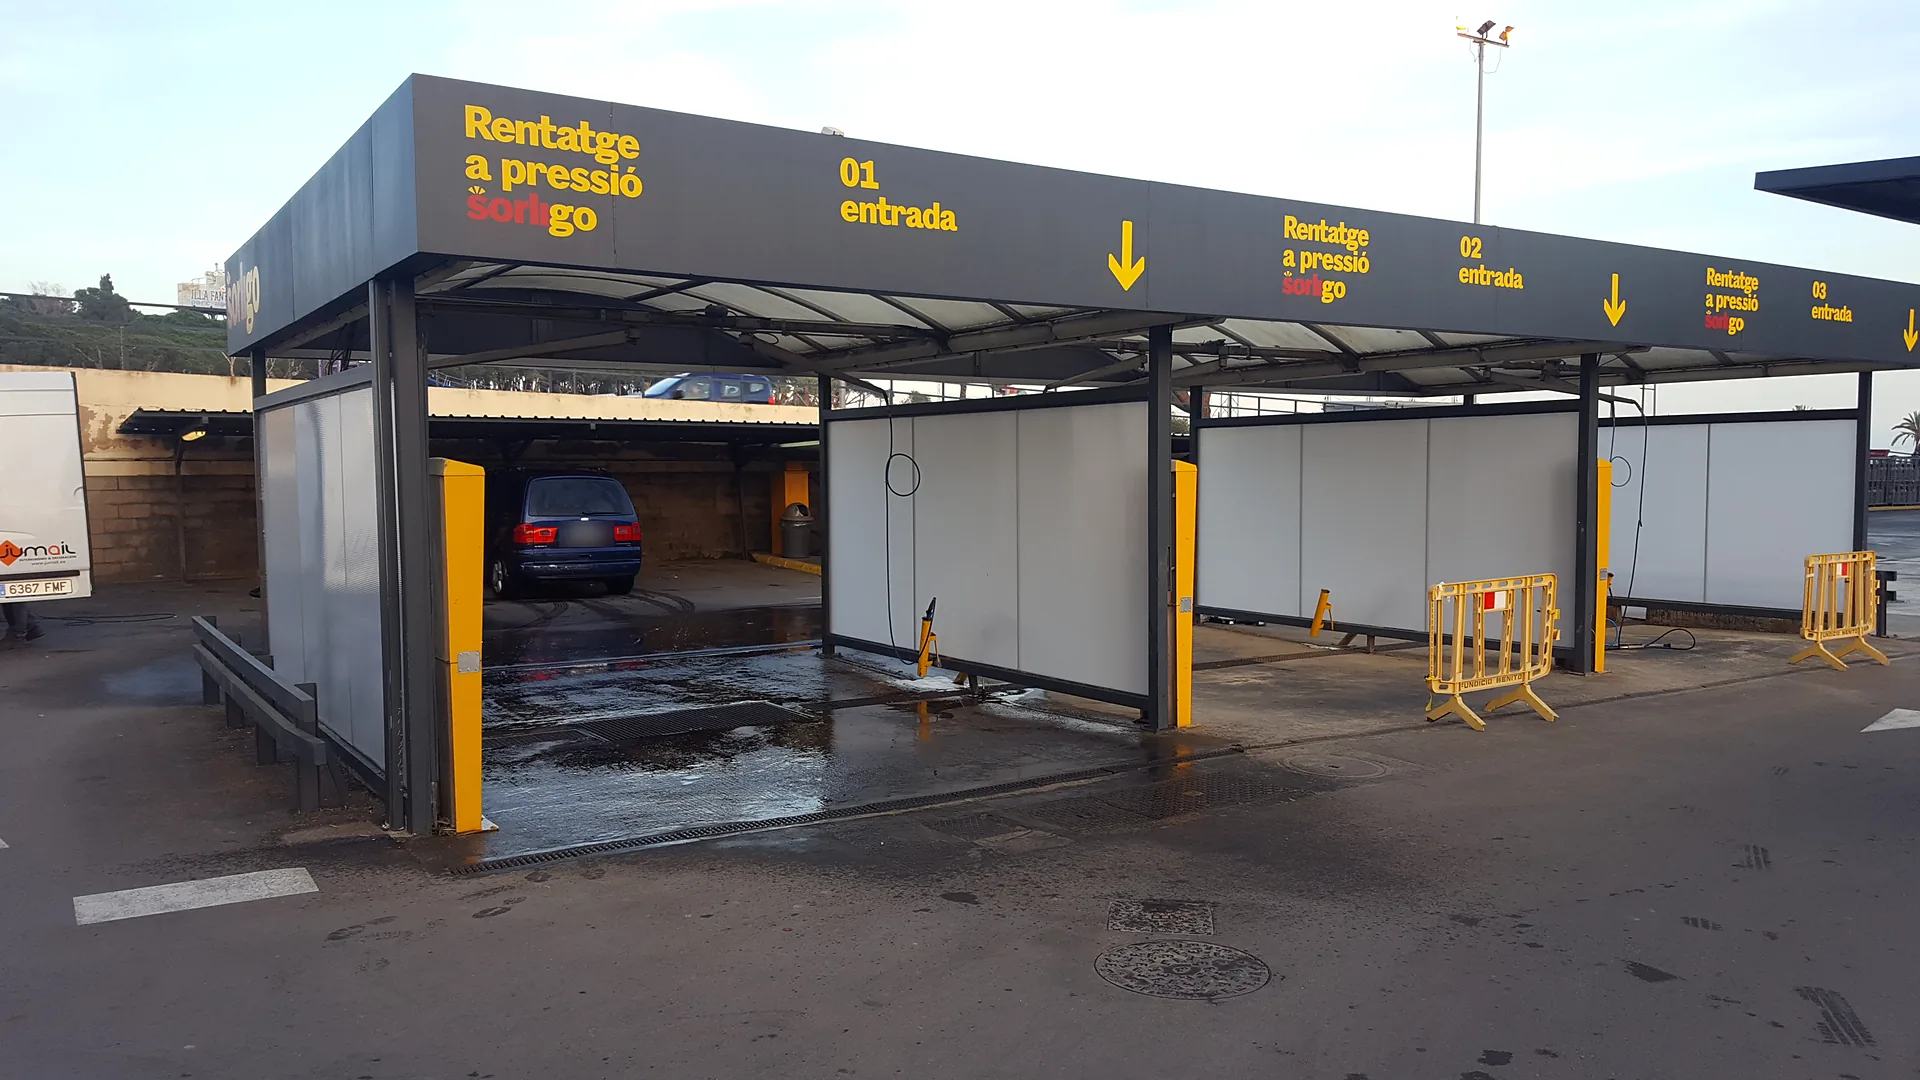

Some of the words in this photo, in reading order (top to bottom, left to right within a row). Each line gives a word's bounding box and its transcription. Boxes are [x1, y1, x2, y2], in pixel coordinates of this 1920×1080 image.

[464, 104, 641, 165] Rentatge
[465, 154, 492, 181] a
[501, 164, 643, 198] pressió
[840, 157, 880, 190] 01
[840, 196, 958, 232] entrada
[1283, 214, 1370, 252] Rentatge
[1460, 235, 1483, 259] 02
[1282, 248, 1296, 268] a
[1299, 250, 1370, 274] pressió
[1458, 264, 1524, 289] entrada
[1706, 267, 1760, 295] Rentatge
[1705, 293, 1714, 308] a
[1715, 293, 1760, 312] pressió
[1811, 280, 1827, 300] 03
[1810, 303, 1853, 323] entrada
[9, 583, 40, 595] 6367
[45, 581, 68, 593] FMF
